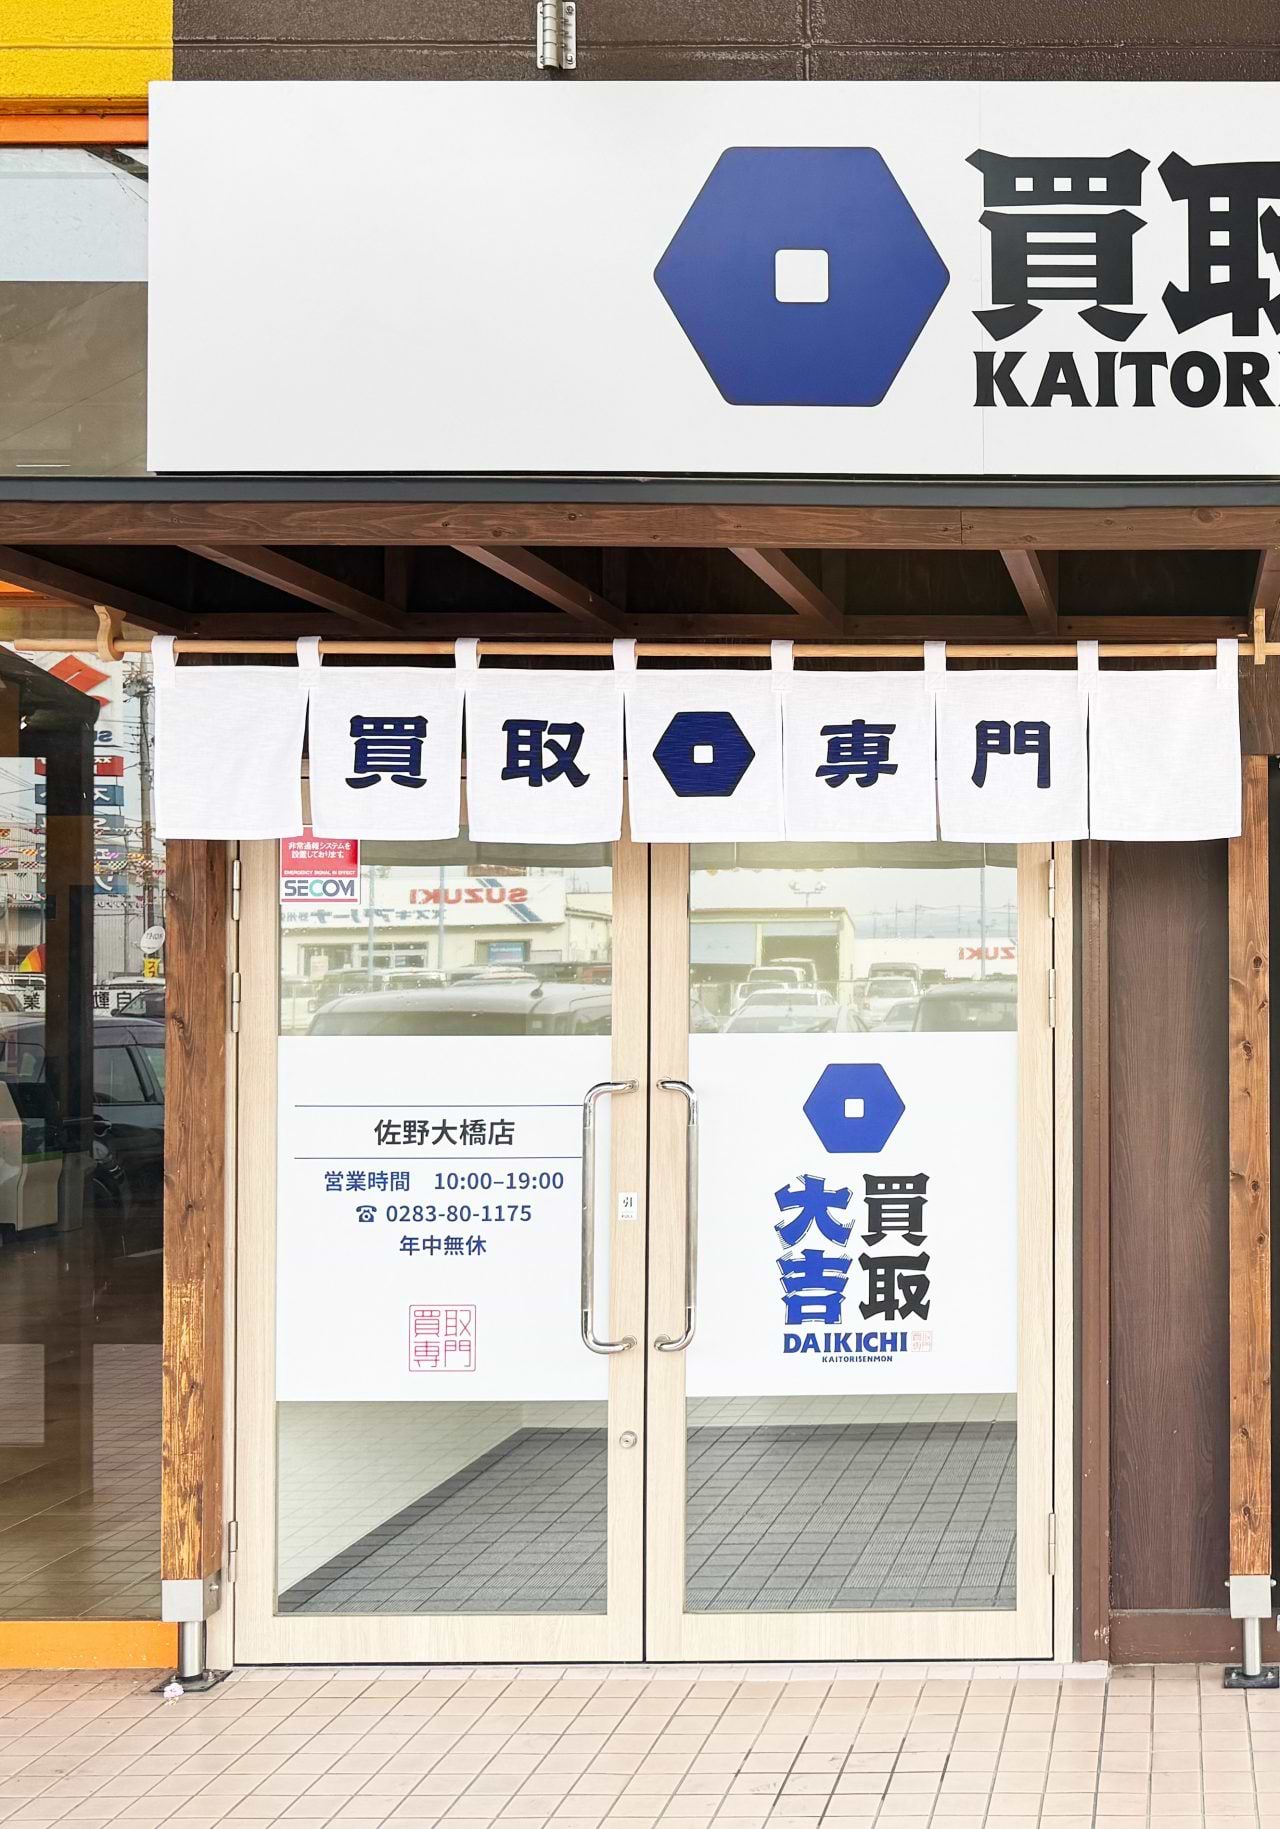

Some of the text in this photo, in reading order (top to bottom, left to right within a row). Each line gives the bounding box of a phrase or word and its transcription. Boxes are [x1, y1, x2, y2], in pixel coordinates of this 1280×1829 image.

[345, 714, 1052, 789] 買取 専門
[284, 879, 355, 897] SECOM
[373, 1118, 515, 1146] 佐野大橋店
[324, 1170, 410, 1192] 営業時間
[386, 1204, 532, 1223] 0283-80-1175
[399, 1234, 487, 1257] 年中無休
[774, 1173, 855, 1325] 大吉
[858, 1172, 930, 1321] 買取
[413, 1309, 472, 1338] 買取
[413, 1340, 472, 1368] 専門
[783, 1331, 908, 1354] DAIKICHI
[822, 1355, 893, 1363] KAITORISENMON
